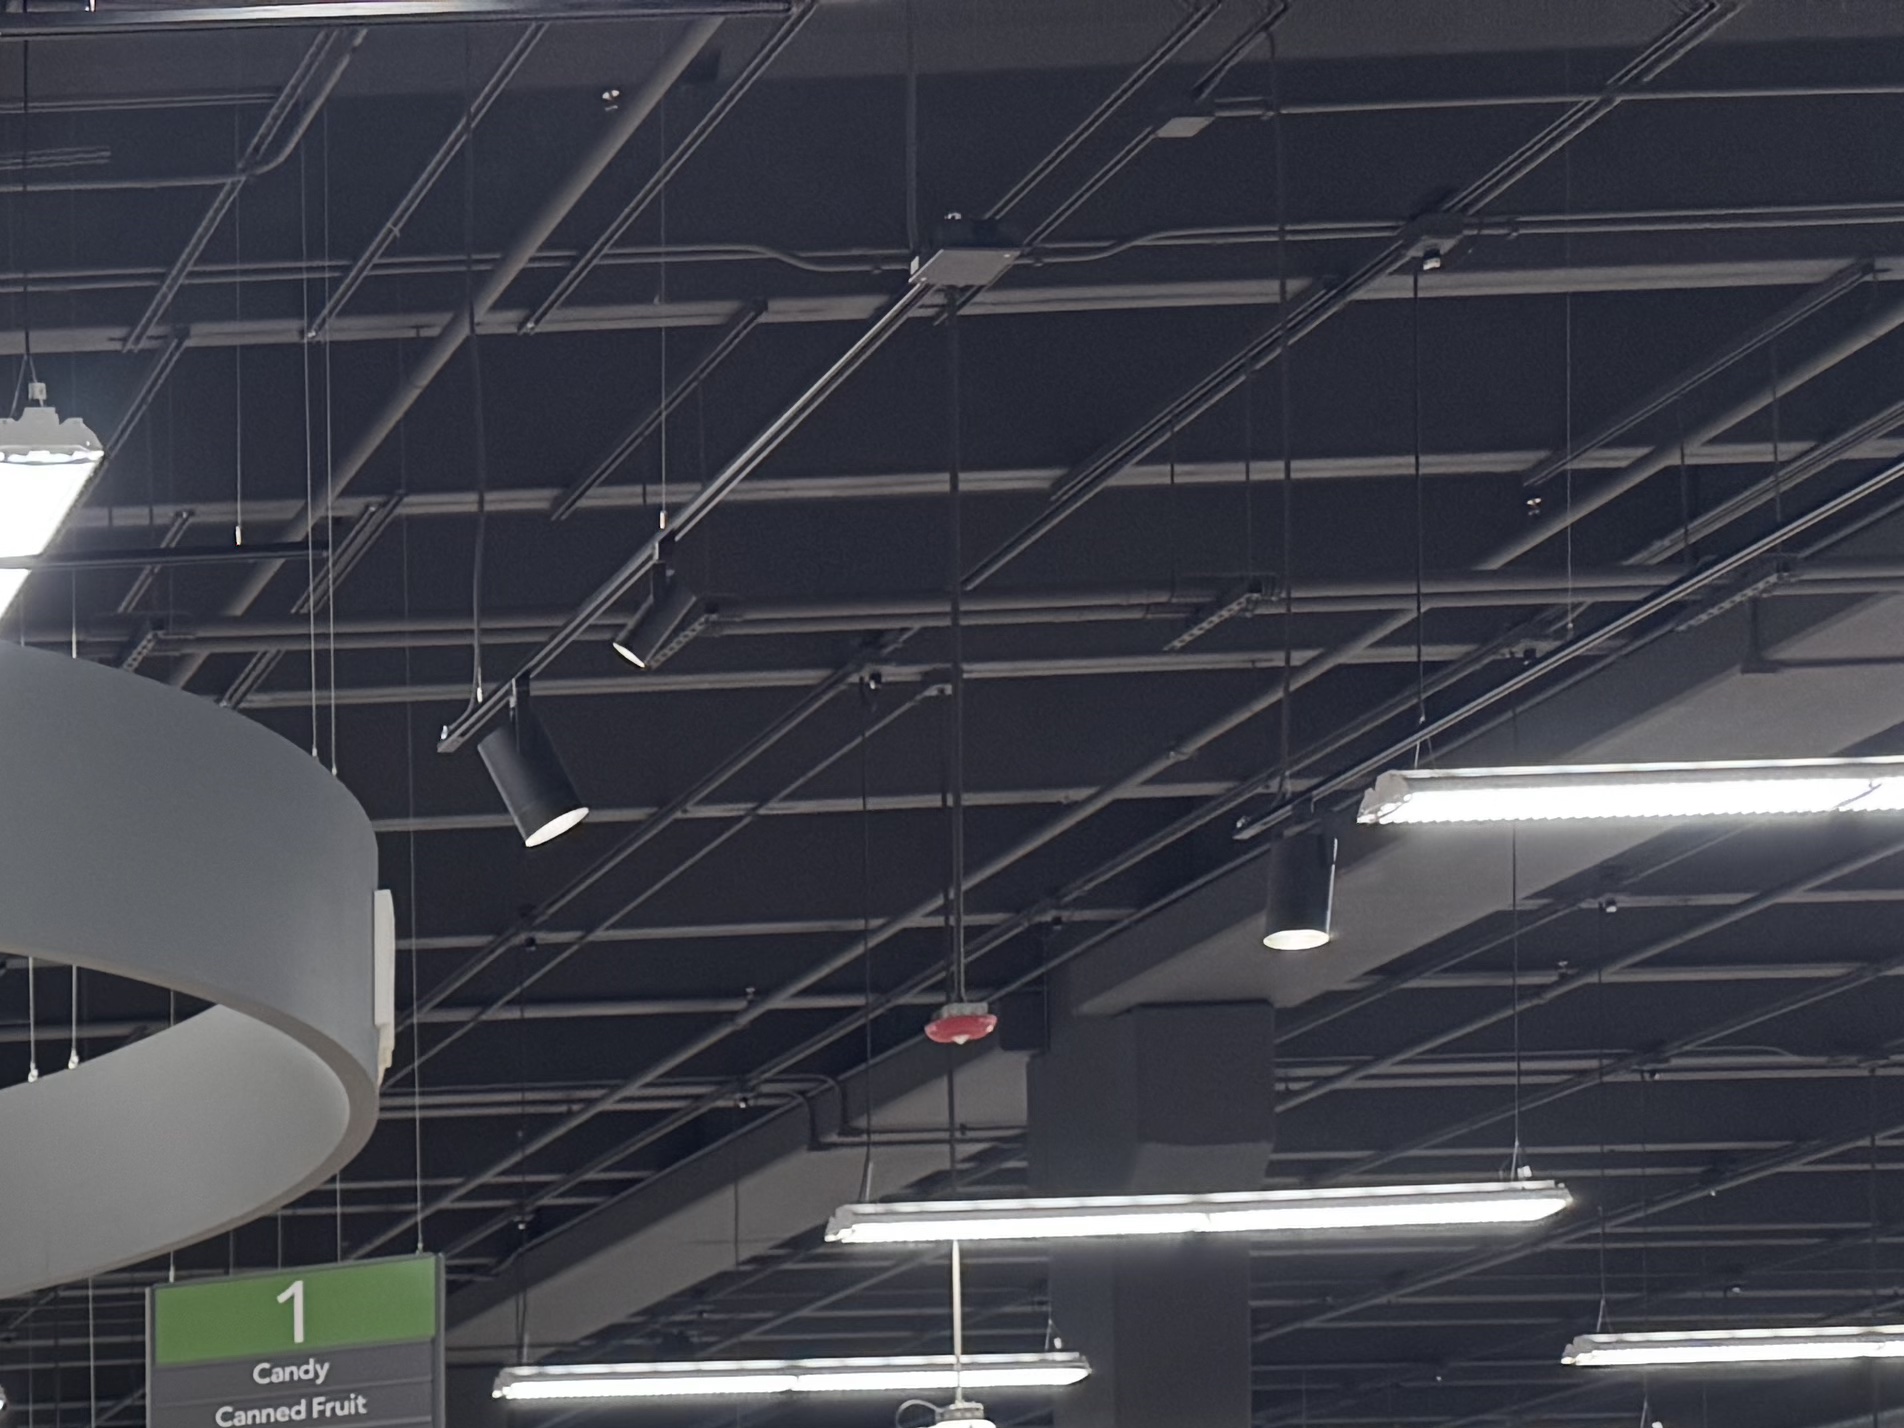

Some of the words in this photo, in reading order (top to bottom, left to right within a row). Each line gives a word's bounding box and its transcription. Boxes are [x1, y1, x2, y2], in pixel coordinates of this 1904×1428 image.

[276, 1280, 305, 1343] 1
[252, 1358, 330, 1385] Candy
[215, 1400, 307, 1428] Canned
[312, 1394, 368, 1419] Fruit
